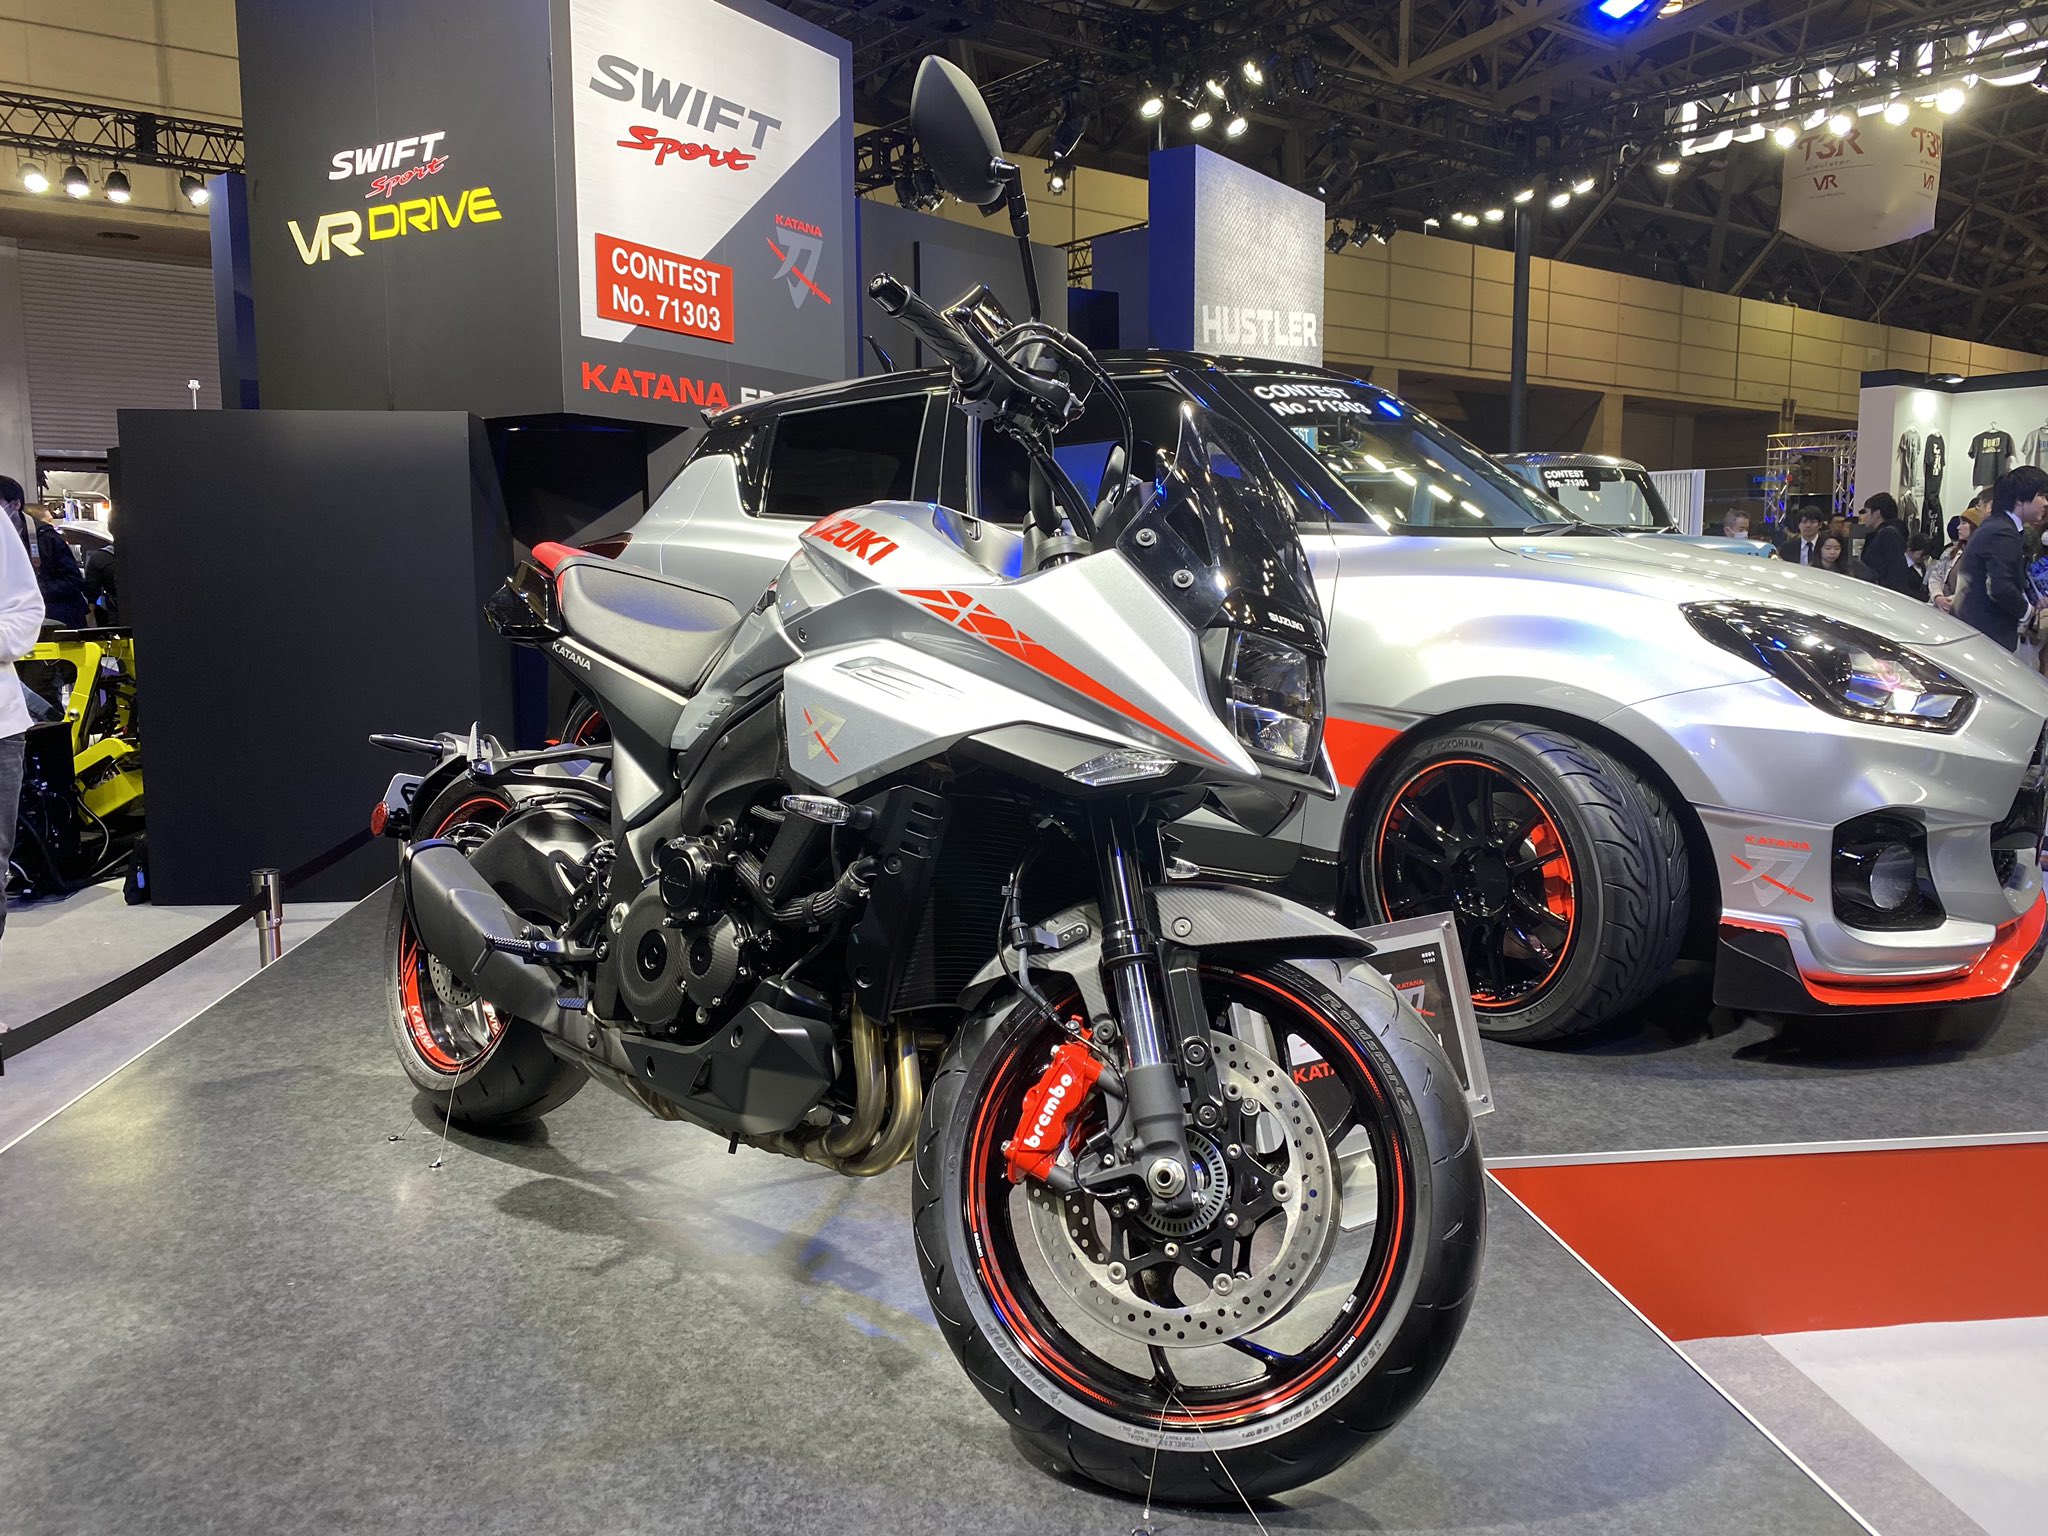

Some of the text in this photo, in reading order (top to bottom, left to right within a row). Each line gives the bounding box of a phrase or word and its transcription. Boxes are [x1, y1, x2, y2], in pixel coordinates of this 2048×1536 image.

[589, 54, 782, 150] SWIFT
[328, 131, 446, 181] SWIFT
[616, 125, 757, 171] Sport
[365, 154, 450, 199] Sport
[1813, 174, 1838, 191] VR
[287, 187, 502, 265] VR DRIVE
[775, 213, 823, 237] KATANA
[611, 247, 721, 297] CONTEST
[612, 283, 721, 332] No. 71303
[1202, 305, 1317, 347] HUSTLER
[581, 361, 729, 407] KATANA
[1253, 384, 1351, 400] CONTEST
[1269, 399, 1372, 417] No. 71303
[1544, 470, 1584, 479] CONTEST
[1547, 479, 1589, 488] No. 71301
[1267, 611, 1305, 632] SUZUKI
[552, 641, 591, 671] KATANA
[1744, 834, 1811, 852] KATANA
[1396, 979, 1424, 990] KATANA
[410, 1005, 436, 1049] KATANA
[1293, 1062, 1335, 1084] KAT
[1023, 1074, 1073, 1149] brembo
[985, 1322, 1049, 1391] DUNLOP
[1336, 1335, 1357, 1358] SUZUKI
